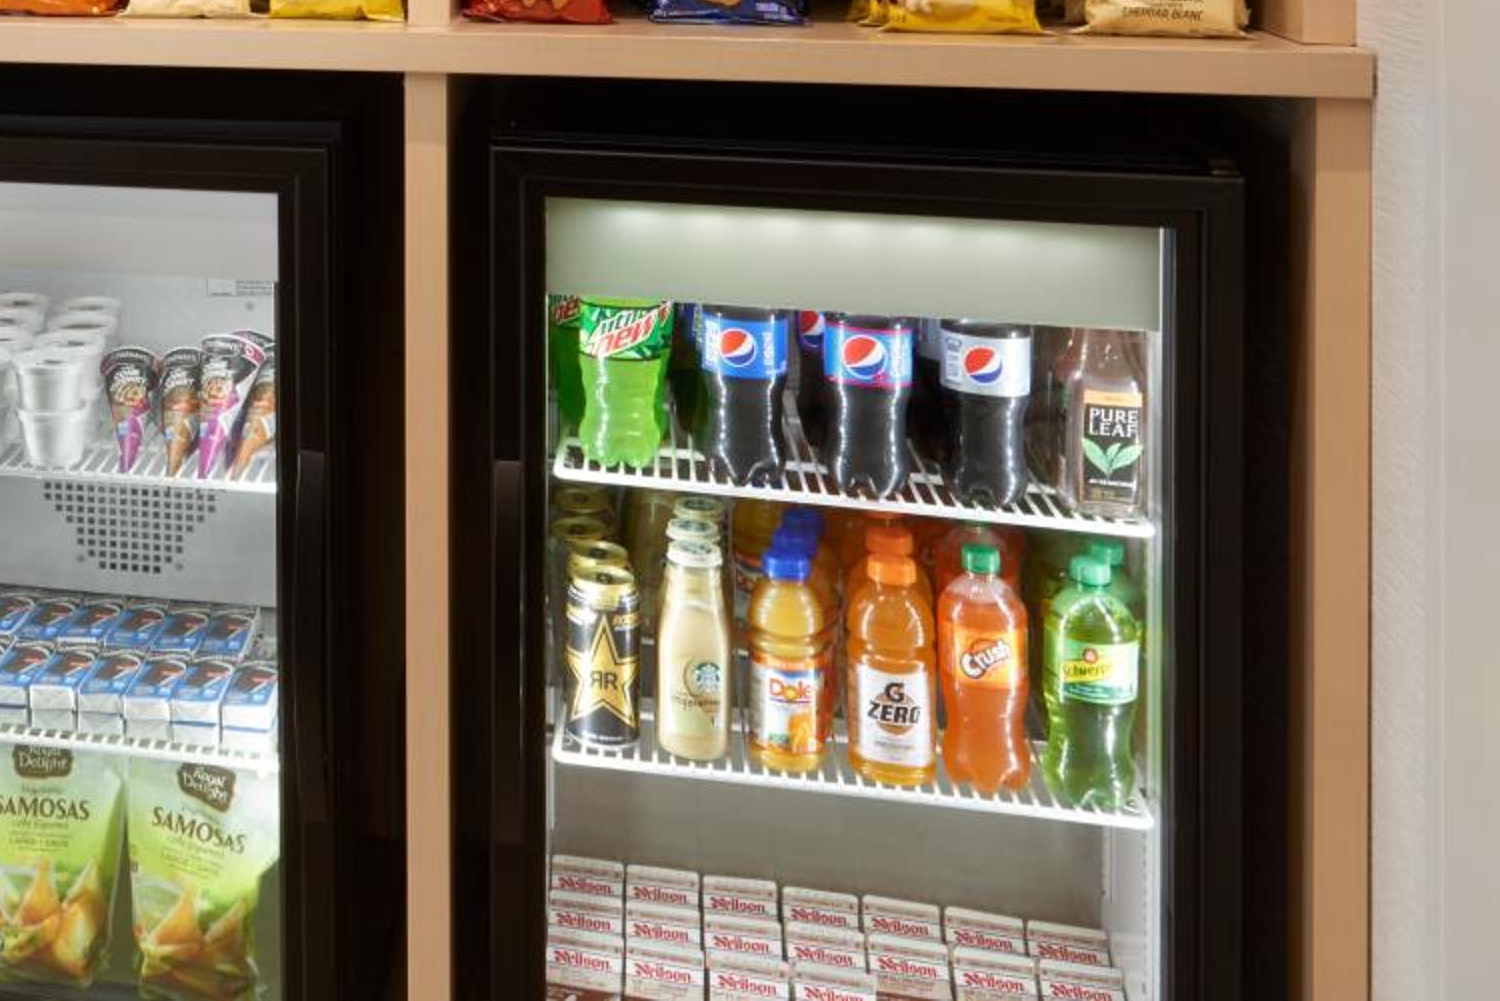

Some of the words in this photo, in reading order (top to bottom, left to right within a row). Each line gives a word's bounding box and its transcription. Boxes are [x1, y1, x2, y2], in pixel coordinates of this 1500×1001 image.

[1090, 406, 1139, 423] PURE
[1090, 421, 1139, 439] LEAF
[961, 639, 1012, 680] Crush
[769, 678, 812, 701] Dole
[884, 682, 905, 703] G
[867, 700, 920, 725] ZERO
[151, 806, 246, 855] SAMOSAS
